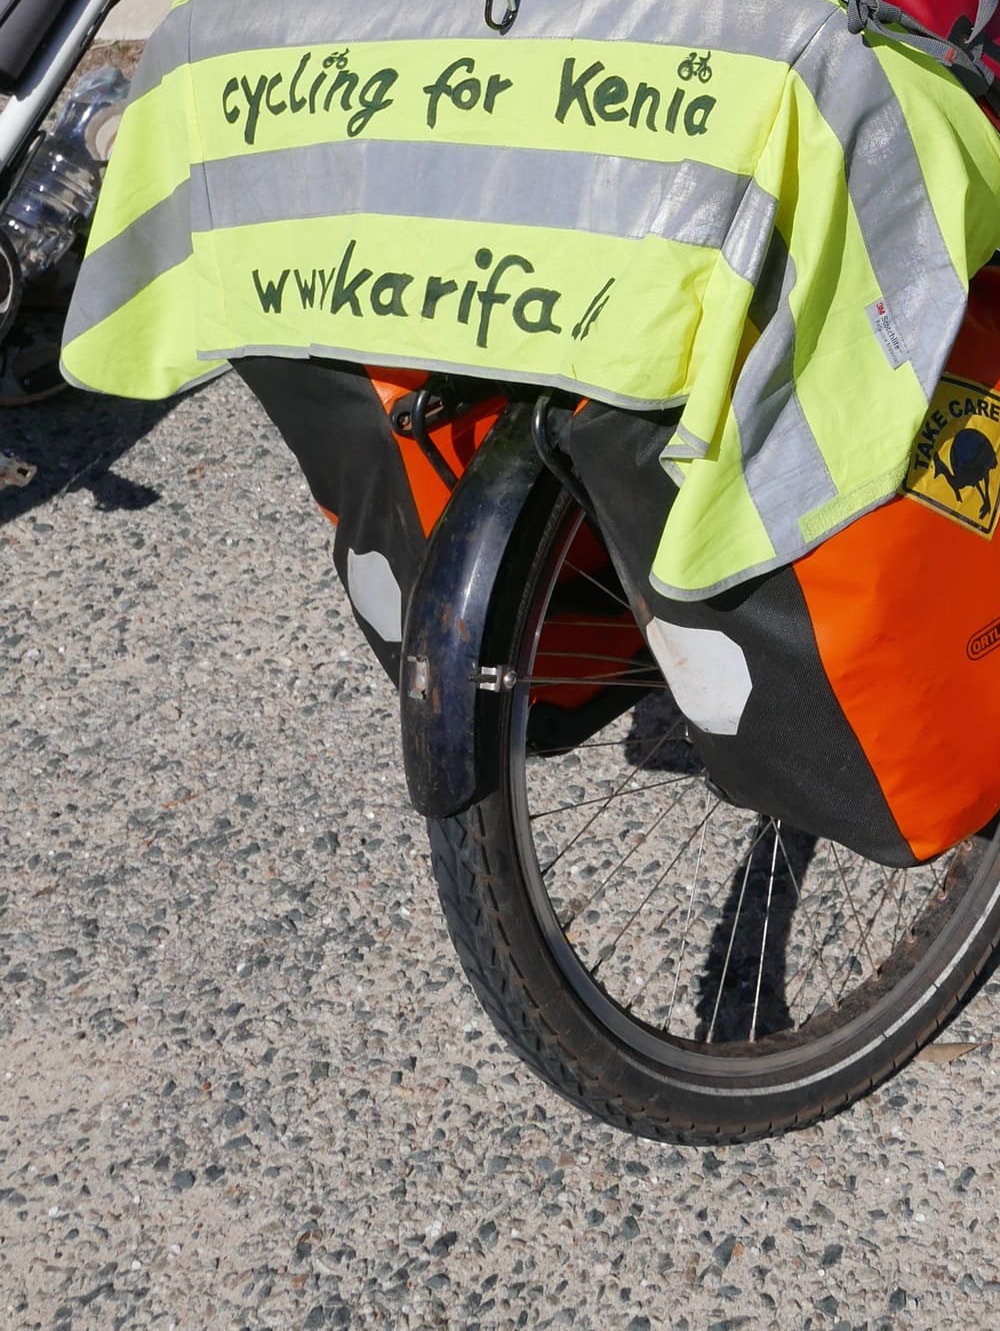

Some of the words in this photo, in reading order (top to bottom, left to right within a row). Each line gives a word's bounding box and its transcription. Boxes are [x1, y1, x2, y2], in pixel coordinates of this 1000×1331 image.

[222, 51, 399, 145] cycling
[423, 56, 514, 129] for
[554, 56, 718, 137] Kenia
[876, 301, 886, 316] 3M
[914, 408, 949, 471] TAKE
[948, 399, 1000, 423] CARE
